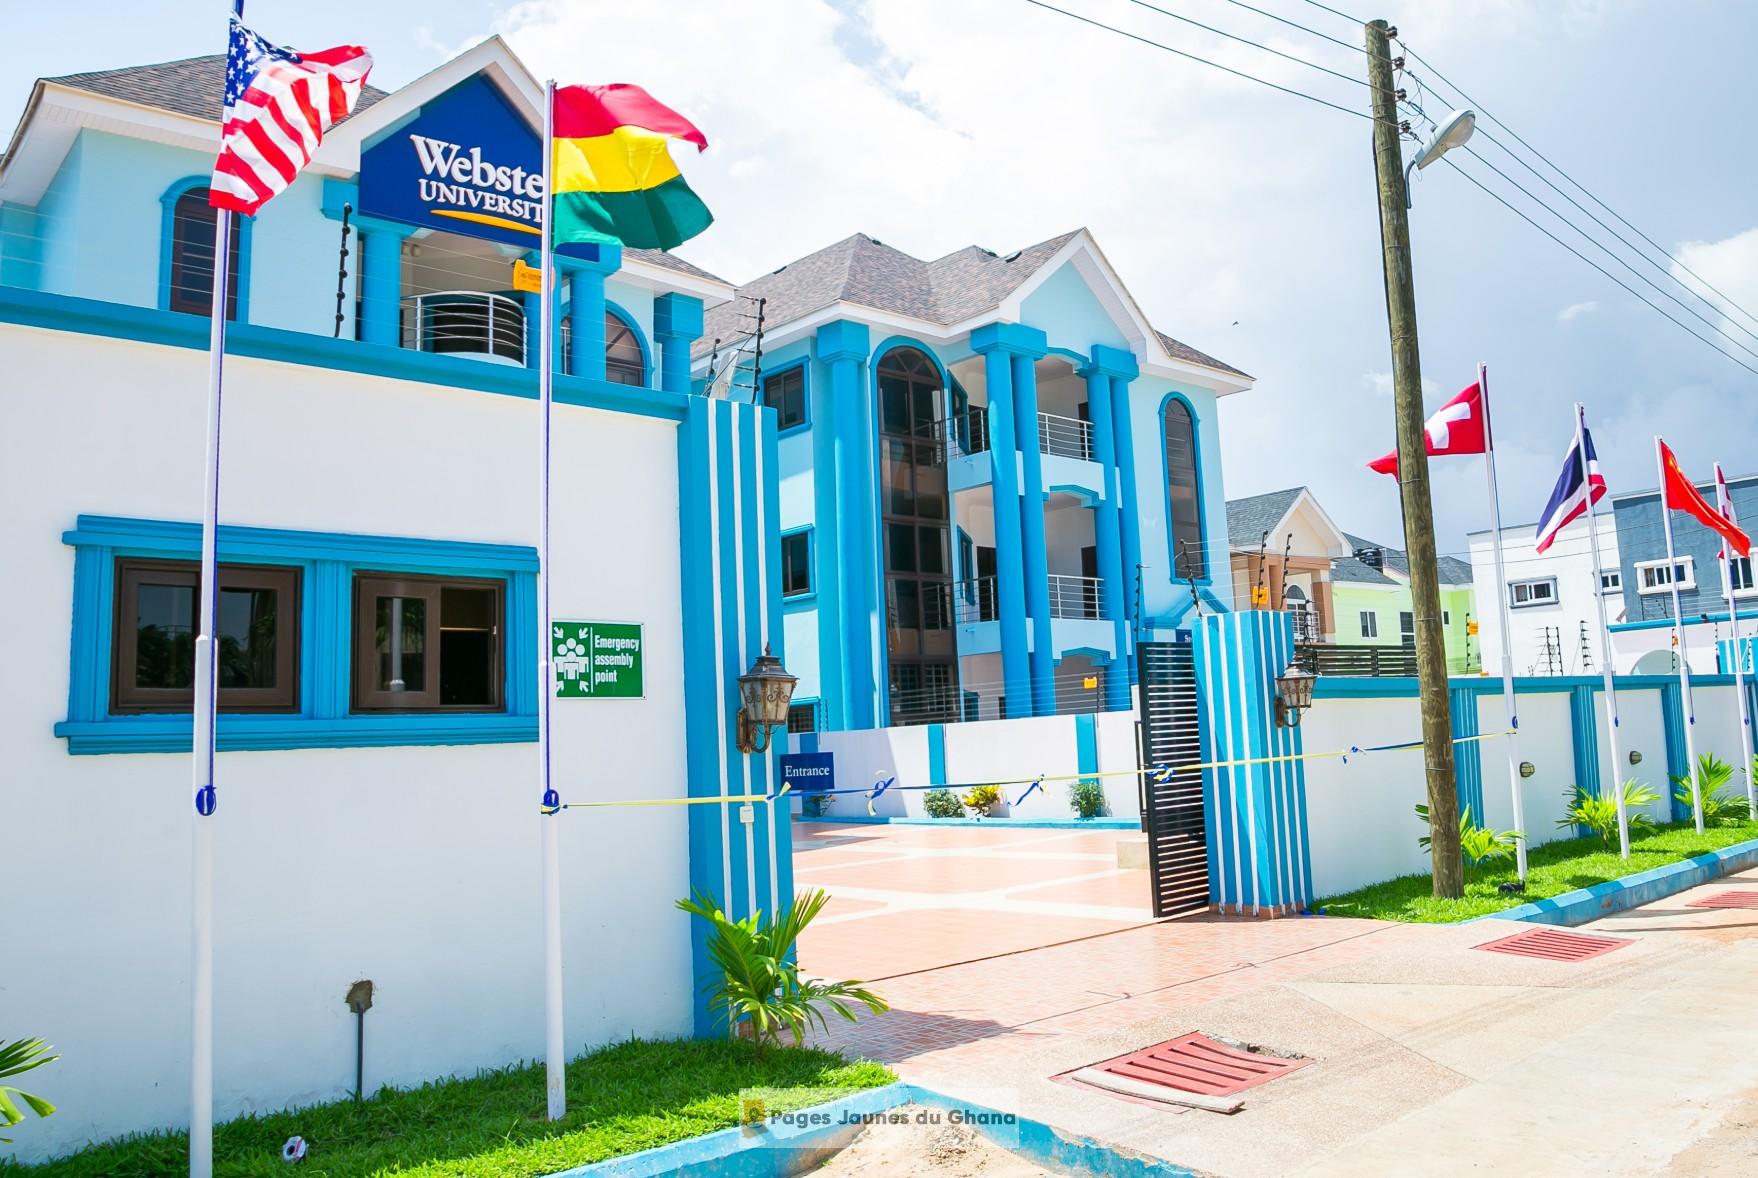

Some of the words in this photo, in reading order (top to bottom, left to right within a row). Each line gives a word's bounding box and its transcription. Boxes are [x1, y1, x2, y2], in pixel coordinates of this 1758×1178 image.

[409, 134, 544, 199] Webste
[418, 178, 544, 223] UNIVERSIT
[594, 634, 640, 652] Emergency
[594, 652, 634, 669] assembly
[594, 669, 618, 686] point
[784, 765, 830, 777] Entrance
